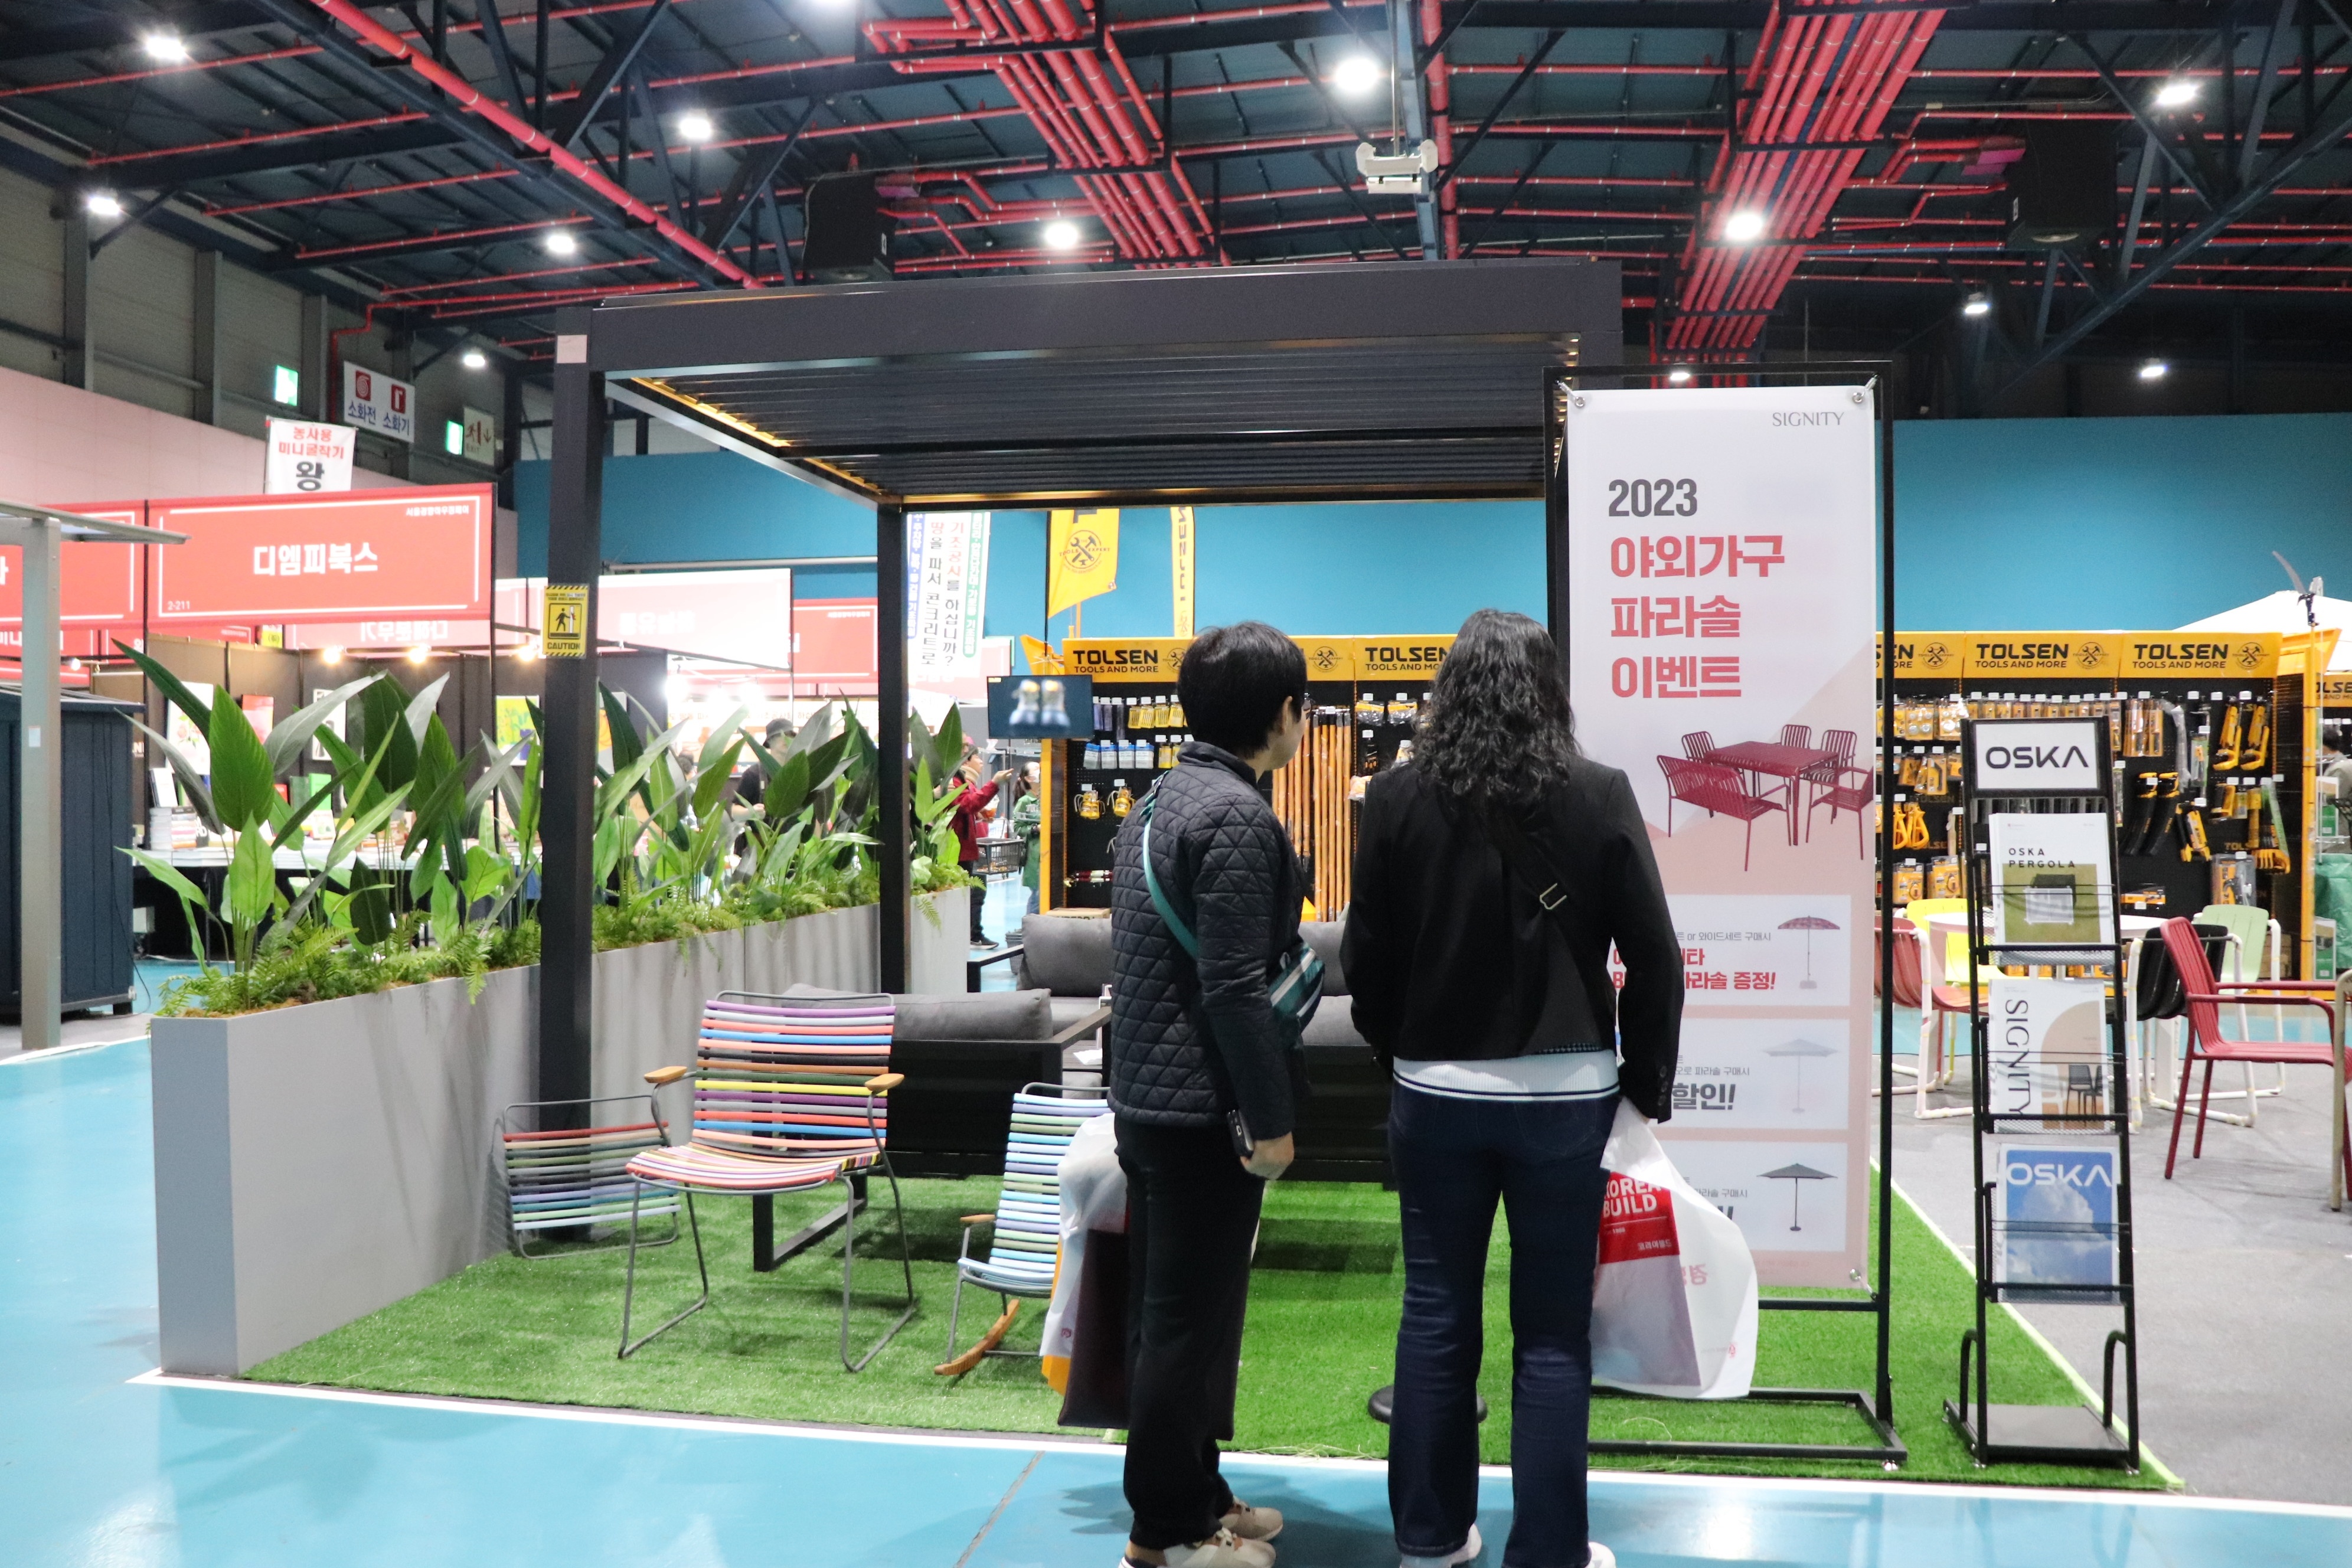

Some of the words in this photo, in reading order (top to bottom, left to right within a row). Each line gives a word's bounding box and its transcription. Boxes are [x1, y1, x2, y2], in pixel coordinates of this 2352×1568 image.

[348, 401, 377, 424] 소화전
[383, 413, 410, 436] 소화기
[1772, 411, 1844, 427] SIGNITY
[293, 426, 333, 442] 농사용
[296, 461, 325, 492] 왕
[1608, 479, 1698, 517] 2023
[930, 522, 945, 550] 땅을
[253, 542, 378, 576] 디엠피북스
[947, 522, 964, 591] 기초공사를
[1611, 535, 1785, 578] 야외가구
[927, 557, 942, 585] 파서
[921, 592, 940, 665] 콘크리트로
[1611, 595, 1742, 638] 파라솔
[943, 599, 959, 666] 하십니까?
[1073, 649, 1158, 665] TOLSEN
[1977, 643, 2069, 659] TOLSEN
[2134, 643, 2229, 659] TOLSEN
[1611, 656, 1742, 699] 이벤트
[1986, 746, 2089, 769] OSKA
[2008, 848, 2045, 856] OSKA
[2008, 860, 2076, 868] PERGOLA
[1698, 932, 1742, 941] 와이드세트
[1745, 932, 1771, 941] 구매시
[1734, 972, 1776, 989] 증정!
[2005, 999, 2031, 1115] SIGNITY
[1695, 1066, 1720, 1076] 파라솔
[1724, 1067, 1750, 1076] 구매시
[1672, 1083, 1736, 1110] 할인!
[2007, 1162, 2112, 1187] OSKA
[1603, 1194, 1657, 1218] BUILD
[1721, 1188, 1747, 1198] 구매시
